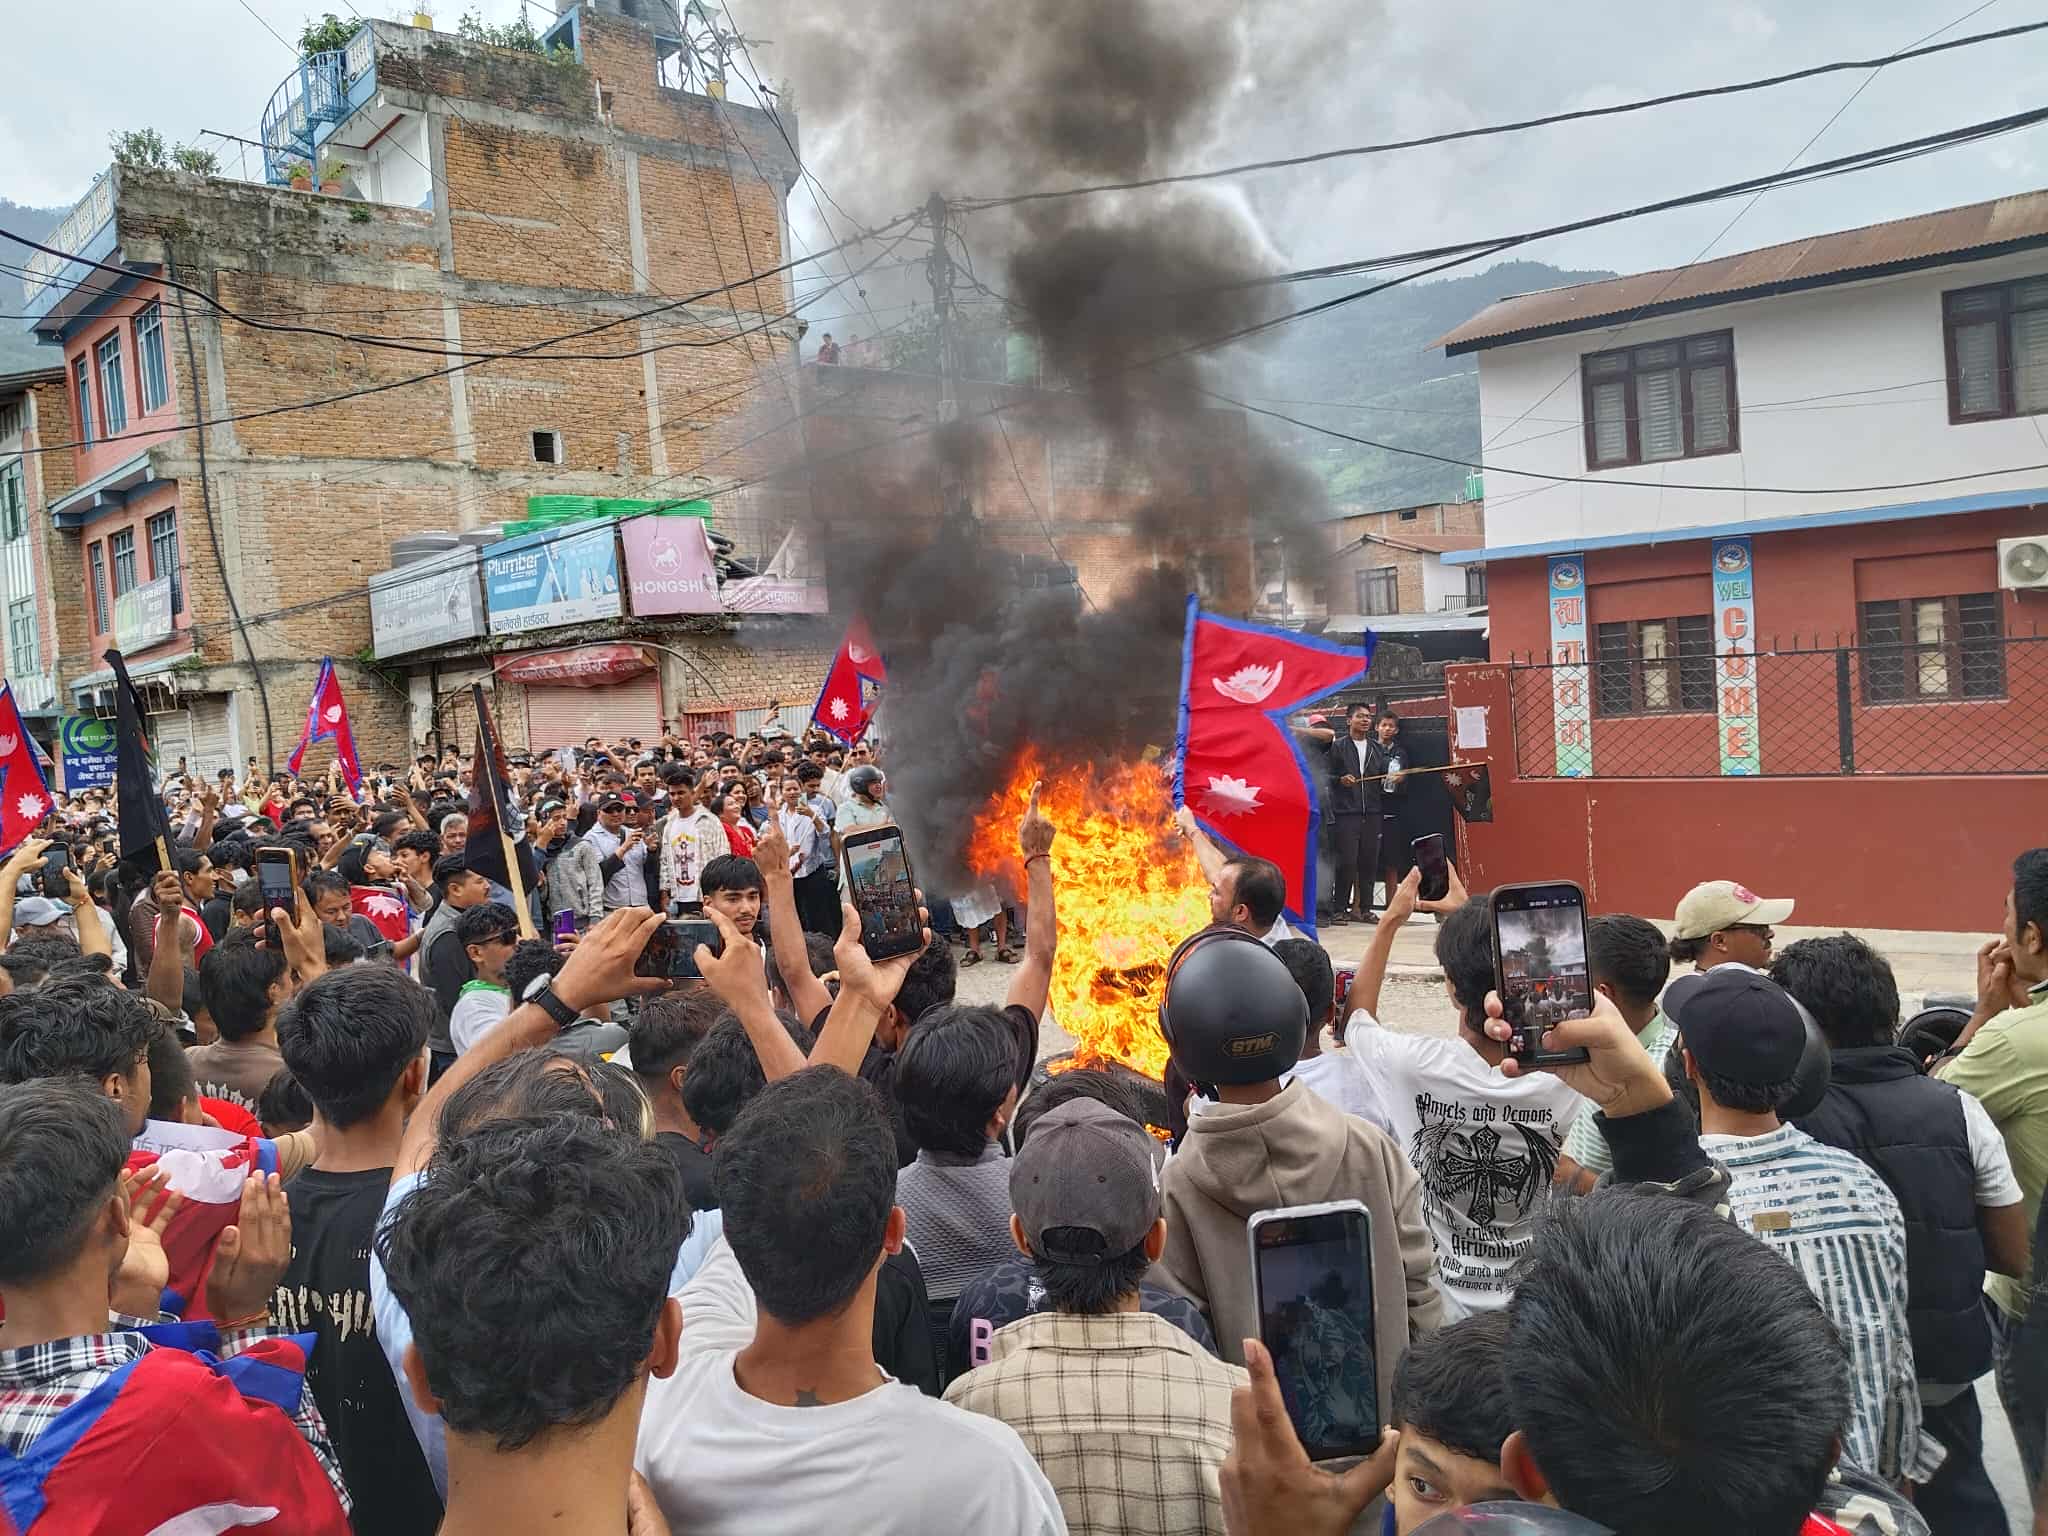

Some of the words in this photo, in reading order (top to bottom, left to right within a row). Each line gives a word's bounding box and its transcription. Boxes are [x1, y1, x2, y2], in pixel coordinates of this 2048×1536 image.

[487, 552, 544, 577] Plumber
[632, 579, 705, 594] HONGSHI
[70, 735, 88, 743] OPEN
[1231, 1036, 1274, 1053] STM
[1472, 1102, 1496, 1123] and
[1502, 1104, 1553, 1125] Demons
